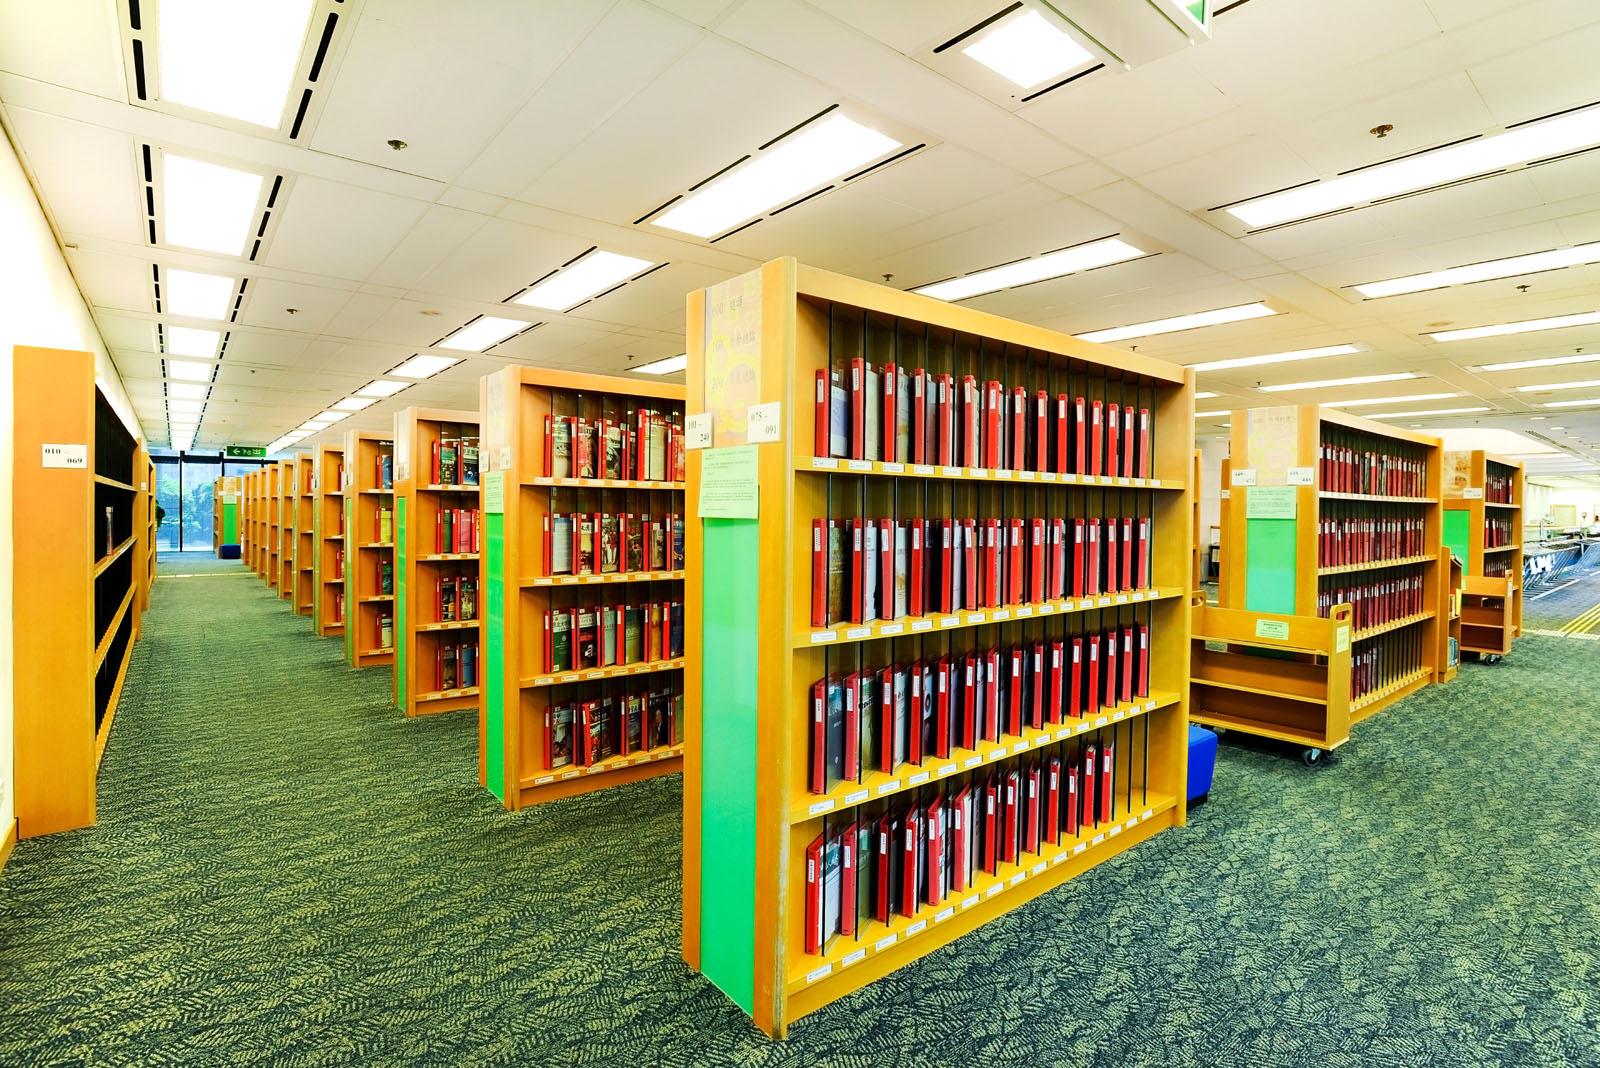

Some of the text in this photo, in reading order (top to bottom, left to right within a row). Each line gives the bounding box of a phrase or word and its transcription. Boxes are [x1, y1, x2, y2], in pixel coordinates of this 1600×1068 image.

[750, 411, 762, 422] 075
[688, 420, 697, 430] 101
[765, 424, 777, 434] 091
